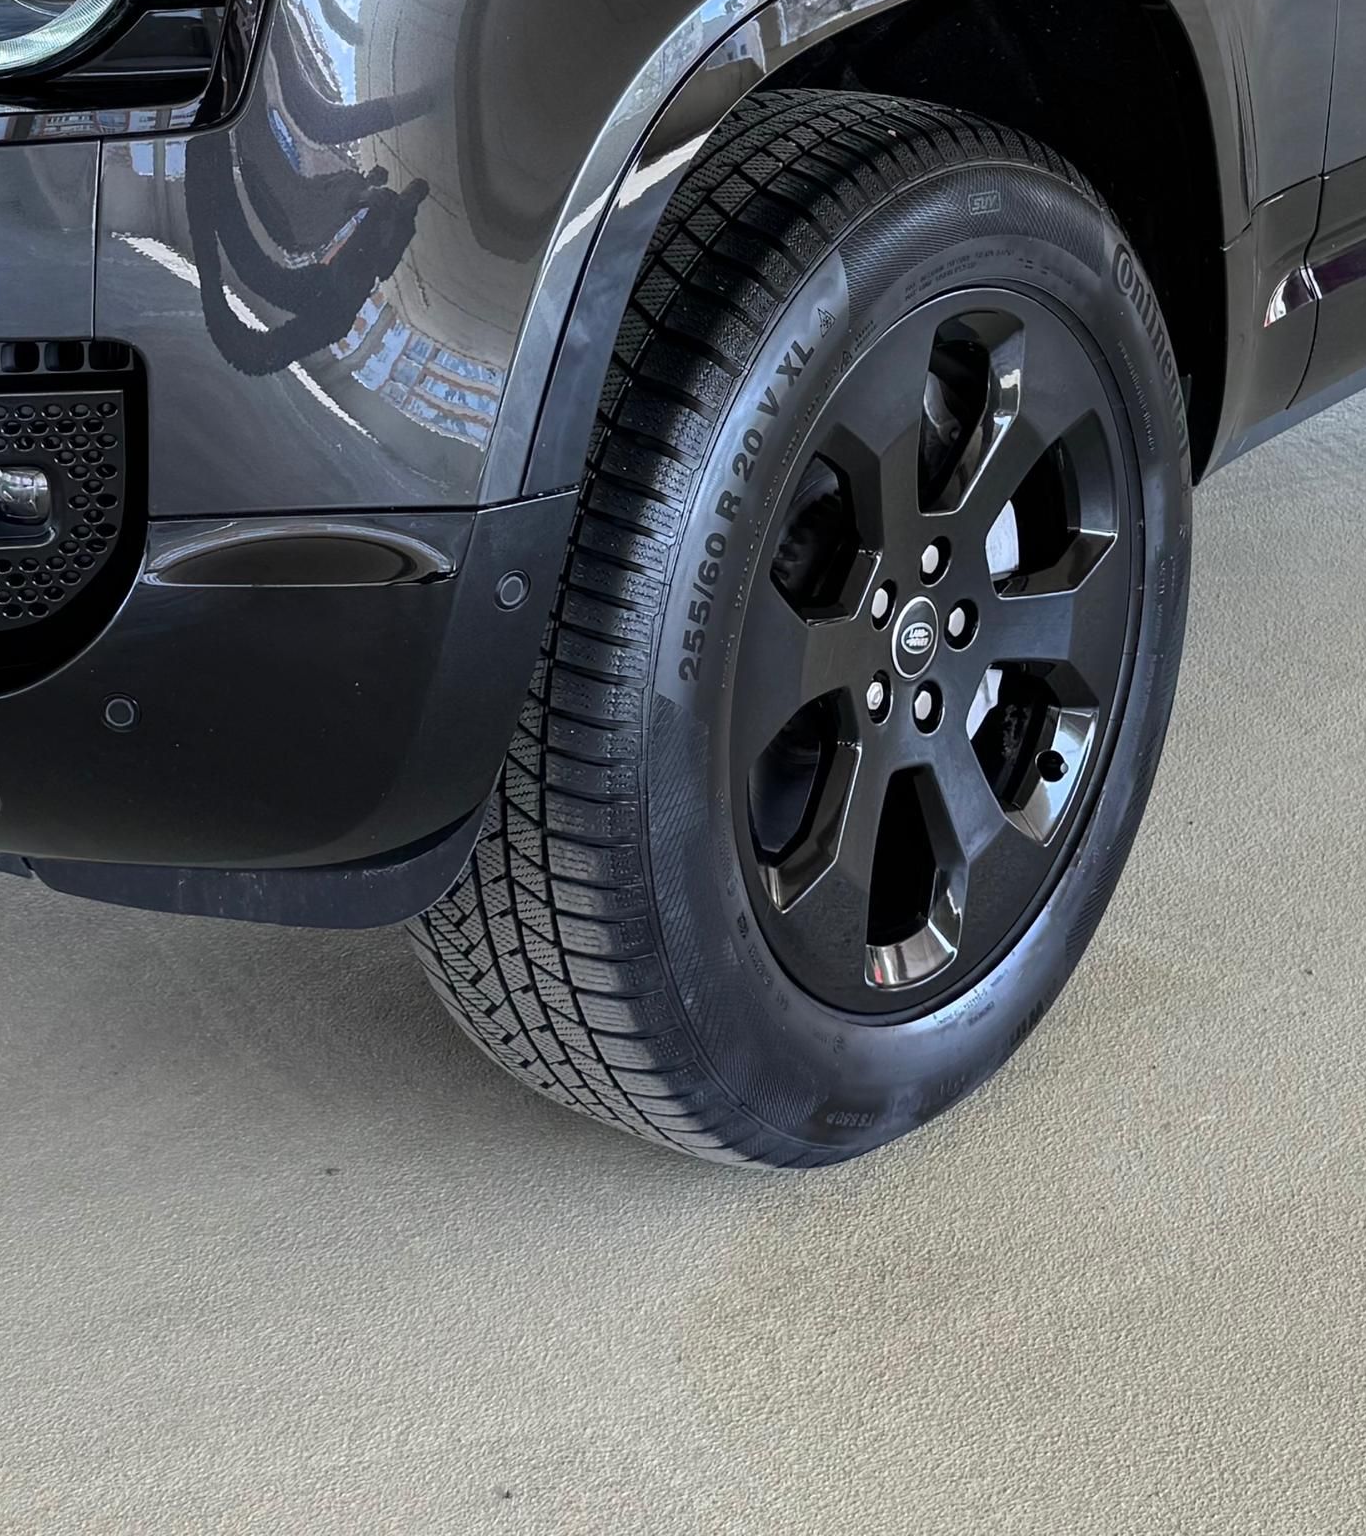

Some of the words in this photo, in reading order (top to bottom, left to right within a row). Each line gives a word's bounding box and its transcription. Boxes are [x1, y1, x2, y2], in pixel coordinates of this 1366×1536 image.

[678, 532, 728, 683] 255/60
[715, 489, 742, 524] R
[732, 427, 764, 483] 20
[756, 385, 781, 418] V
[775, 339, 816, 388] XL
